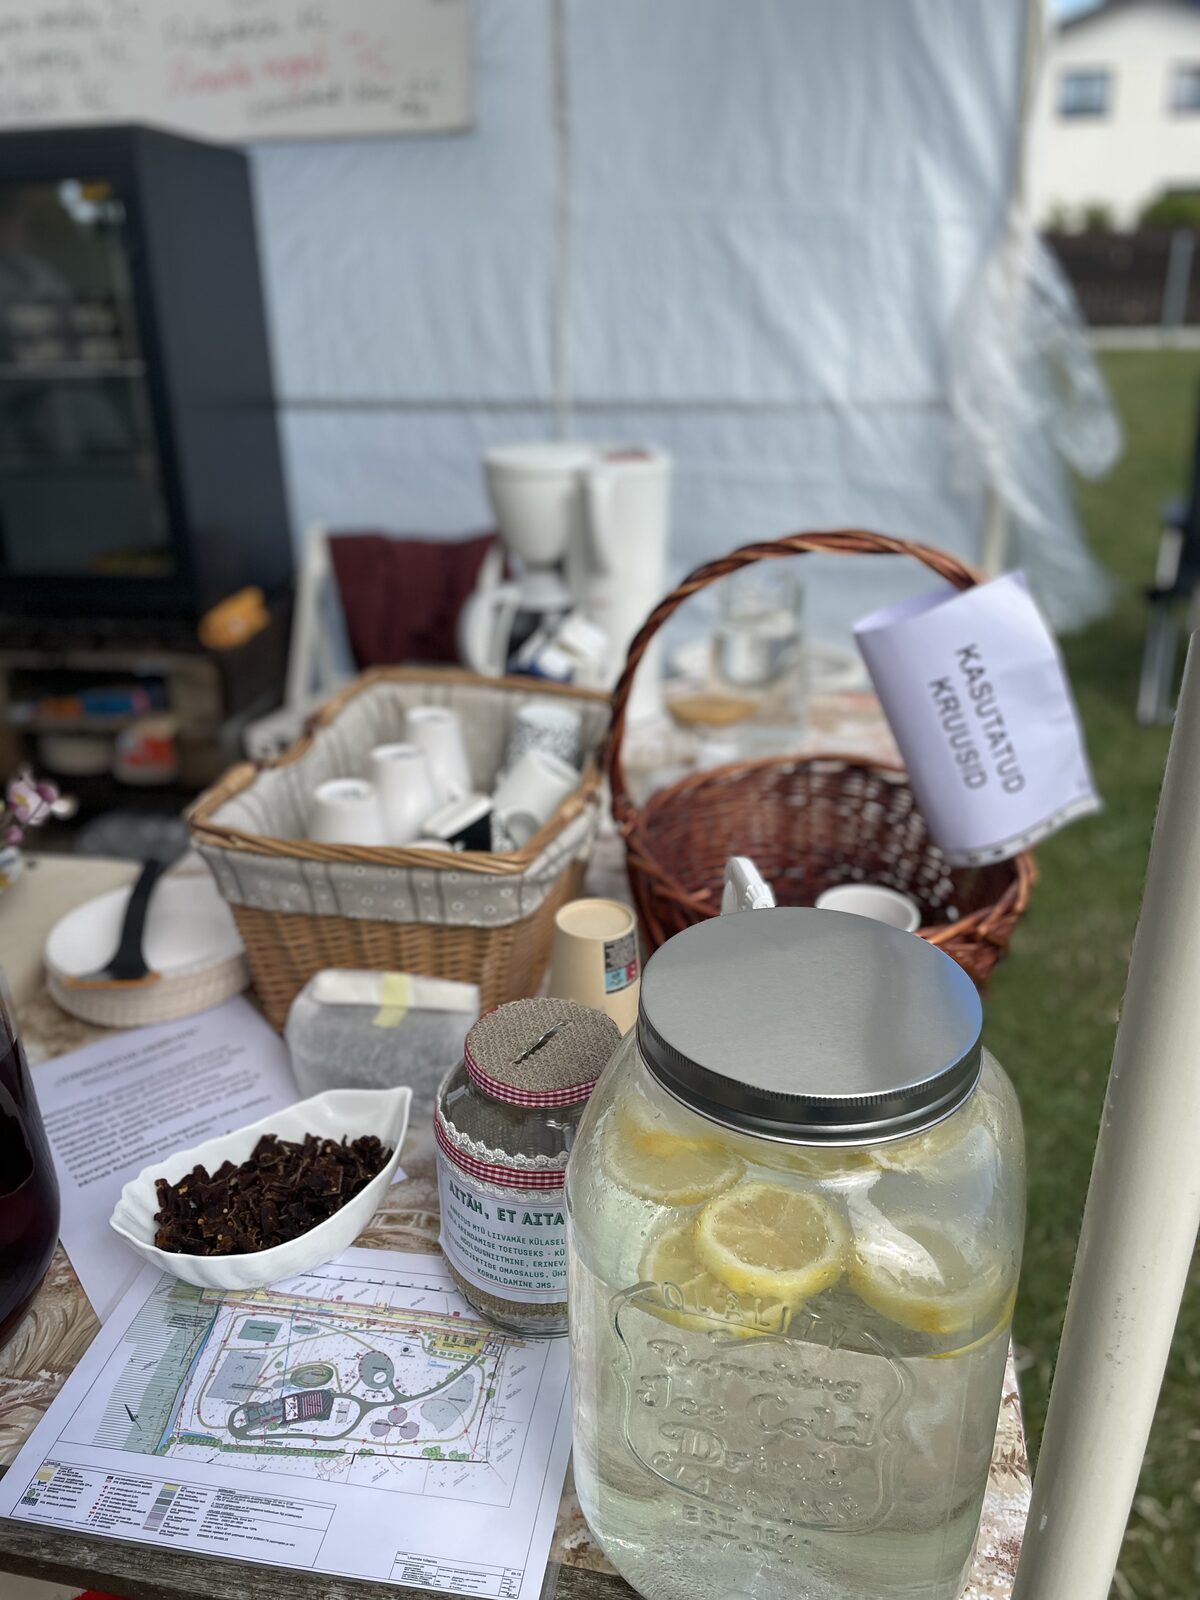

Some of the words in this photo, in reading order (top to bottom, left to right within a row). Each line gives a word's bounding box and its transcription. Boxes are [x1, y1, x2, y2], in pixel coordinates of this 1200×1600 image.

[955, 643, 1025, 794] KASUTATUD
[929, 676, 988, 790] KRUUSID
[449, 1180, 489, 1220] AITÄH,
[496, 1207, 516, 1223] ET
[472, 1222, 486, 1234] MTÜ
[487, 1230, 526, 1245] LIIVAMÄE
[498, 1245, 544, 1258] TOETUSEKS
[477, 1268, 533, 1289] KORRALDAMINE
[499, 1267, 549, 1279] OMAOSALUS,
